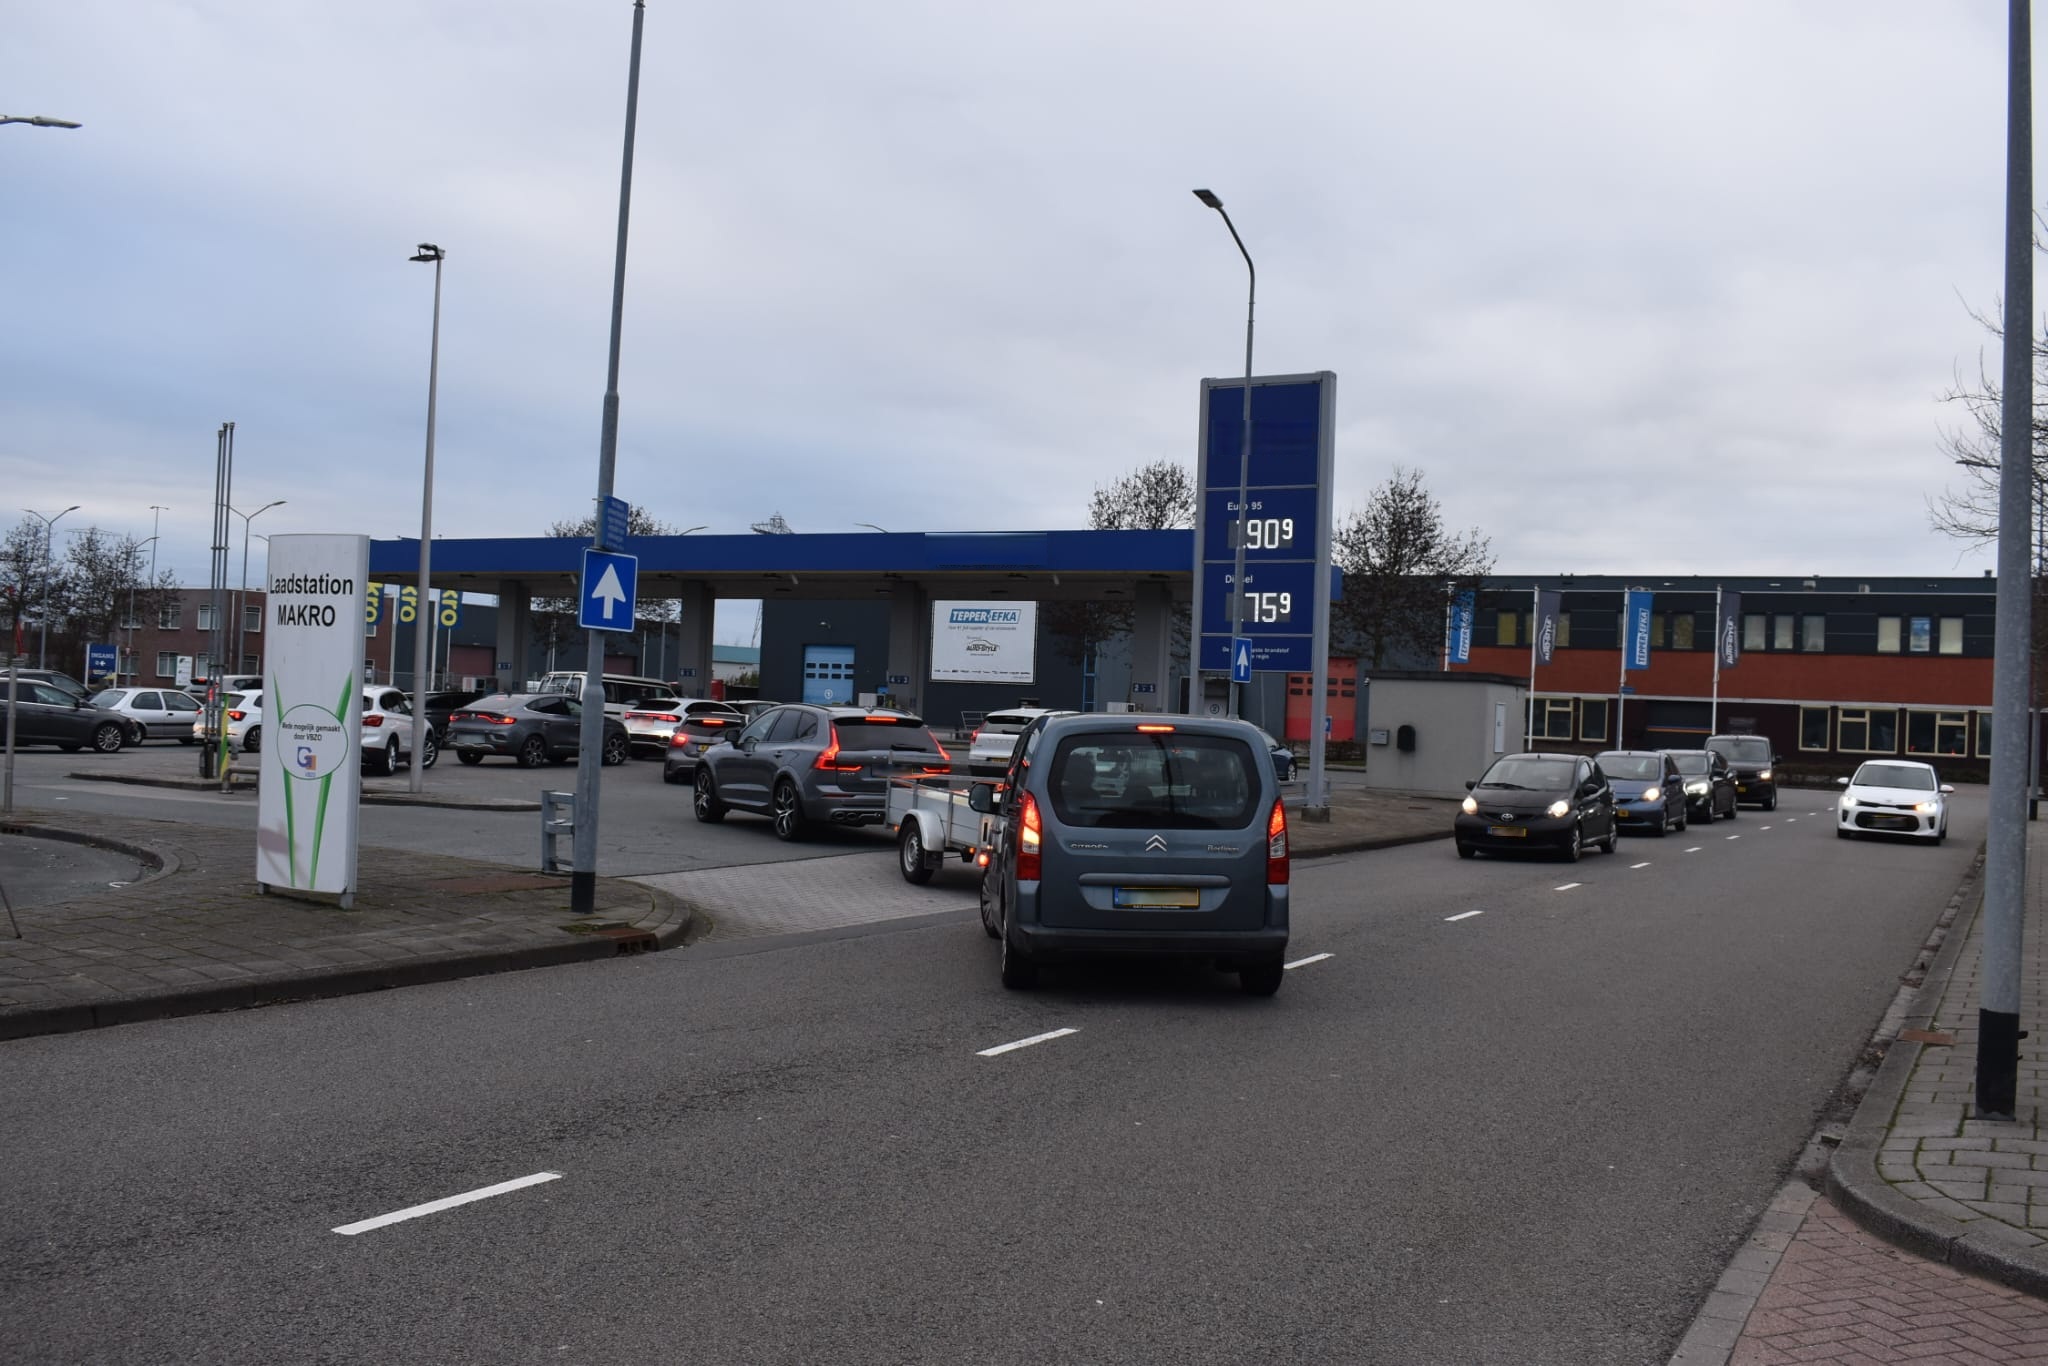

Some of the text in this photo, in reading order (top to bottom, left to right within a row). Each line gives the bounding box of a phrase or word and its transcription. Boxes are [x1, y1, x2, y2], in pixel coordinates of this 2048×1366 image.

[1227, 502, 1262, 510] Euo 95
[270, 573, 353, 595] Laadstation
[1225, 575, 1253, 584] Diel
[1240, 592, 1291, 622] .759
[277, 604, 335, 627] MAKRO
[991, 611, 1016, 622] EFKA
